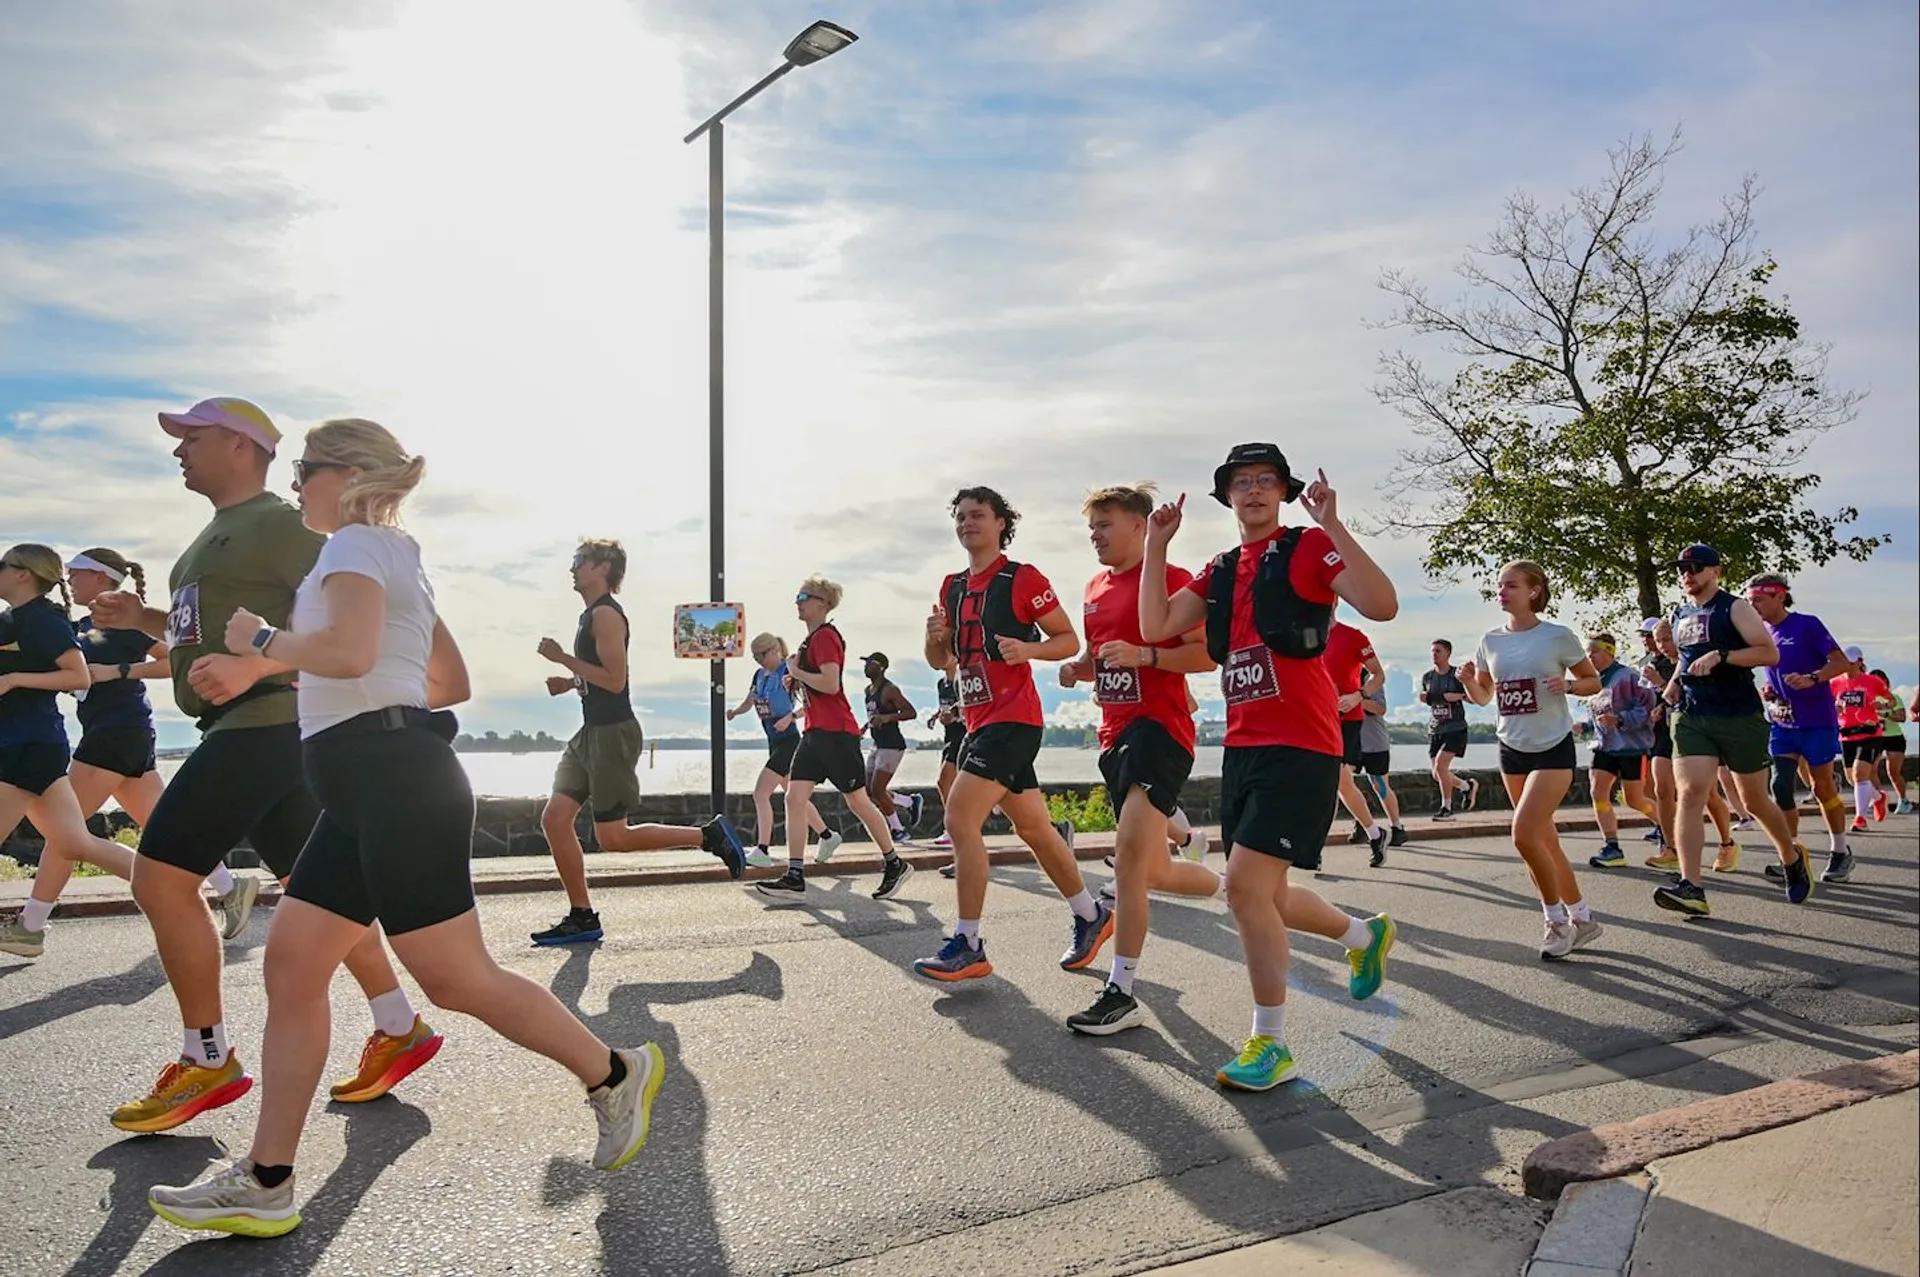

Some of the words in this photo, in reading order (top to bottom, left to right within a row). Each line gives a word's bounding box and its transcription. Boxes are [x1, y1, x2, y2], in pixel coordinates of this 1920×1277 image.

[1098, 672, 1133, 692] 7309
[1226, 663, 1264, 692] 7310
[1499, 689, 1534, 709] 7092
